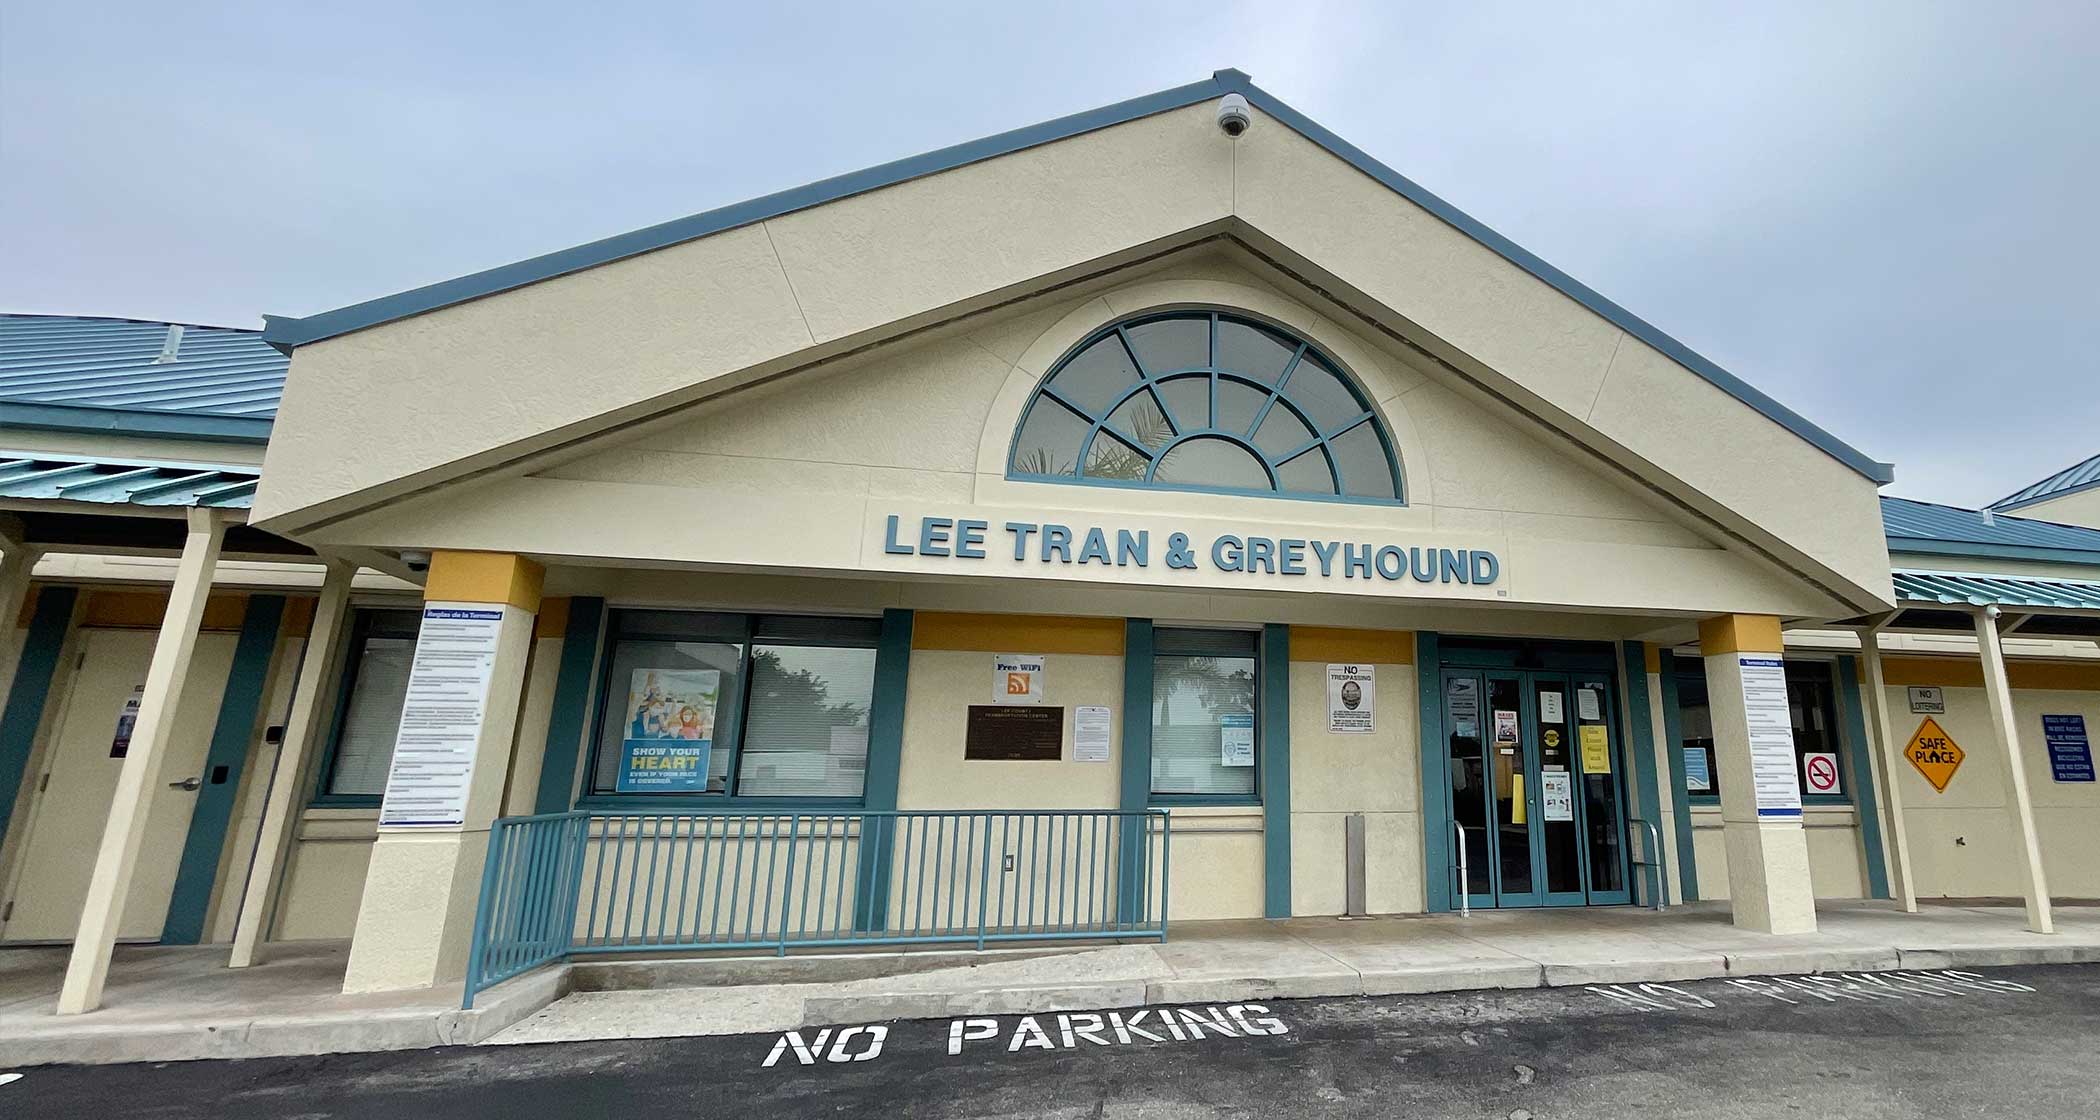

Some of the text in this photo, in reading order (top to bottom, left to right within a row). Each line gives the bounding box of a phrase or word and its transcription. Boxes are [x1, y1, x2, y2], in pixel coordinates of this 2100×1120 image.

[886, 515, 1500, 586] LEE TRAN & GREYHOUND
[427, 611, 450, 619] Reglas
[469, 612, 501, 620] Terminal
[997, 663, 1018, 671] Free
[1343, 665, 1358, 674] NO
[1919, 690, 1932, 698] NO
[1912, 702, 1944, 711] LOITERING
[1920, 737, 1947, 750] SAFE
[632, 748, 701, 756] SHOW YOUR
[631, 757, 699, 769] HEART
[760, 1003, 1290, 1068] NO PARKING
